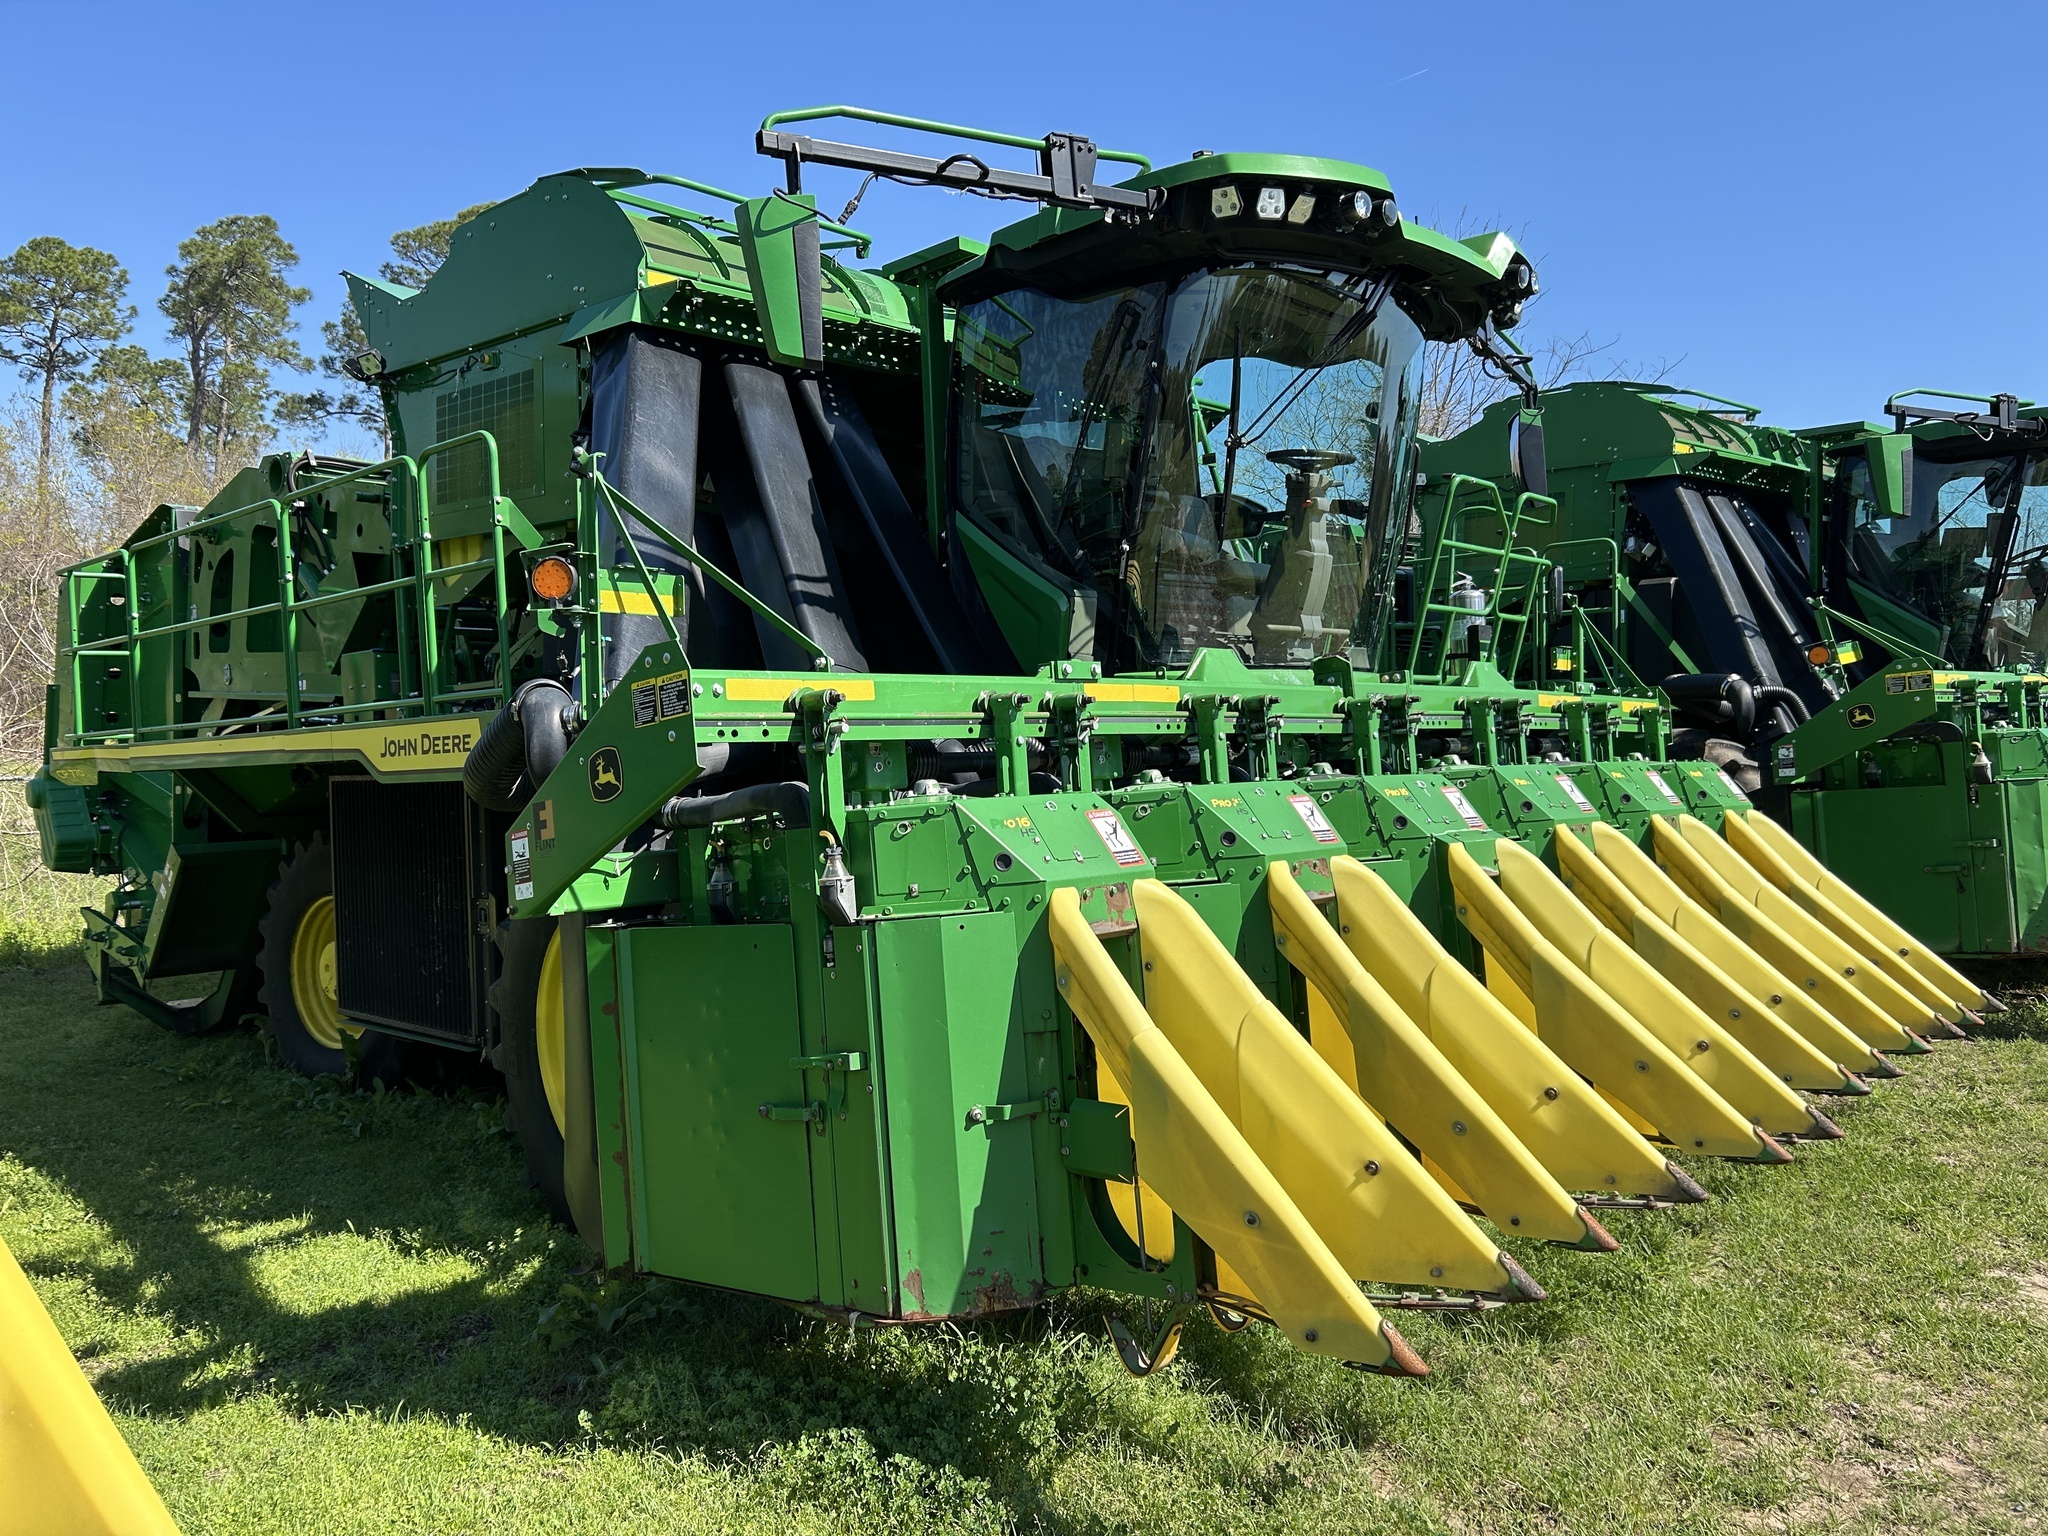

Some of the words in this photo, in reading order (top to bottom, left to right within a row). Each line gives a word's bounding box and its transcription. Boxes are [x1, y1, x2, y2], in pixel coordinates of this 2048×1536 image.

[665, 674, 683, 683] CAUTION
[380, 737, 418, 758] JOHN
[421, 733, 472, 755] DEERE
[1210, 798, 1231, 808] PRO
[1015, 816, 1031, 828] 16
[535, 839, 556, 852] FLINT
